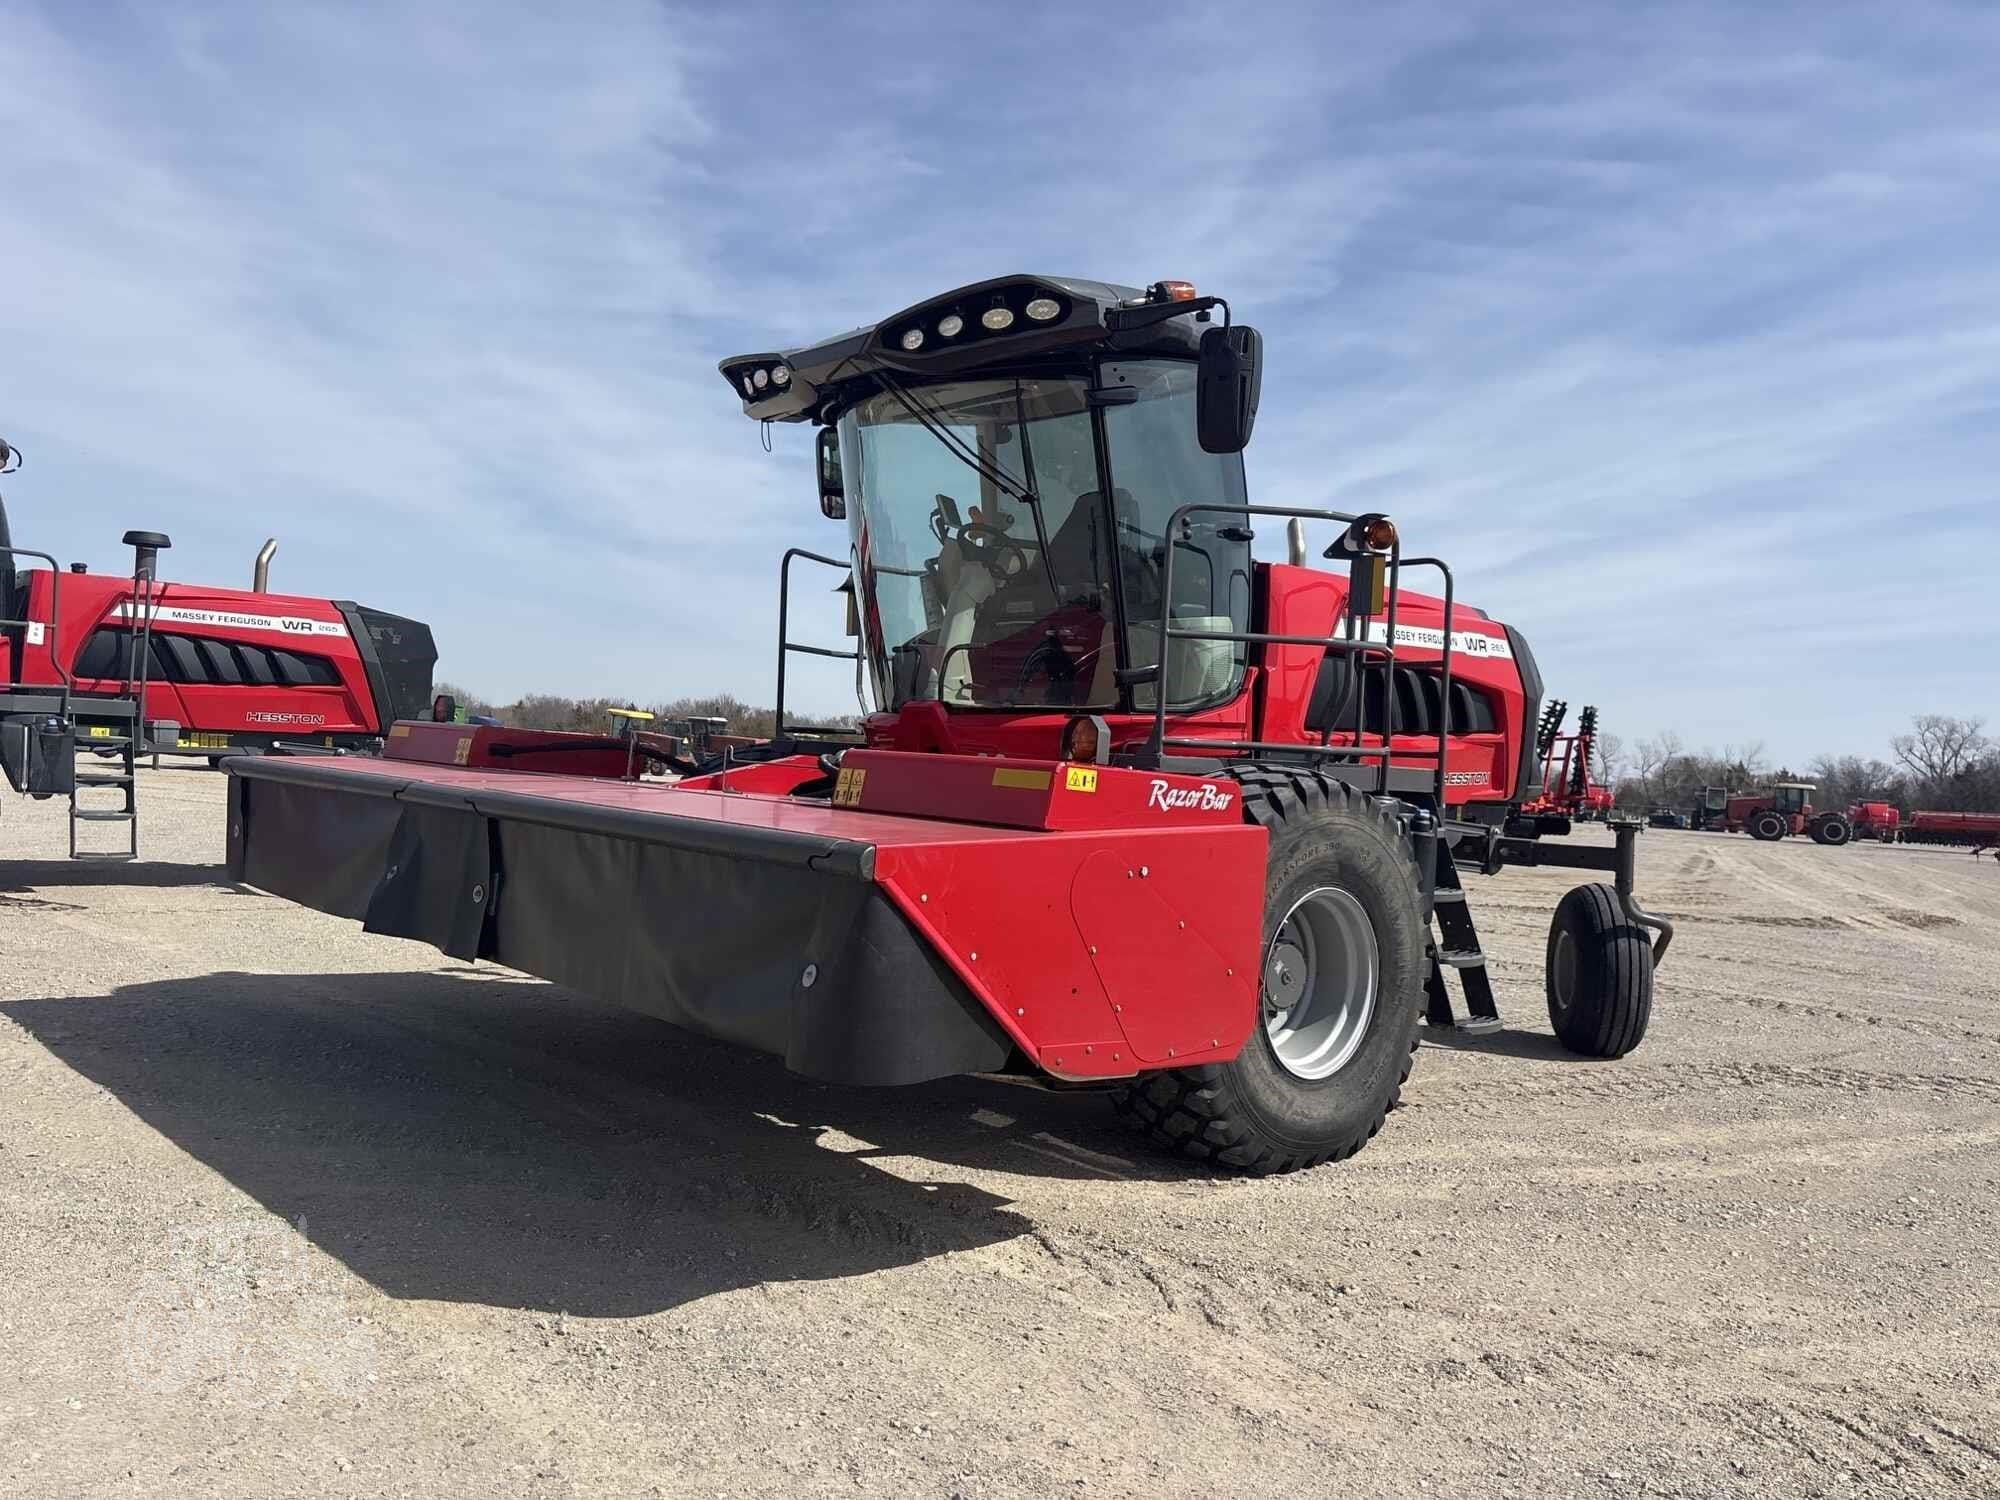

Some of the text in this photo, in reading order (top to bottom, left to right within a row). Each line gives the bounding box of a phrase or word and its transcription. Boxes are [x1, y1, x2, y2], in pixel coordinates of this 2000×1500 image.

[171, 610, 216, 622] MASSEY
[217, 615, 272, 627] FERGUSON
[281, 619, 313, 632] WR
[1382, 628, 1416, 641] MSSEY
[1418, 632, 1458, 647] FERGUN
[1464, 636, 1488, 653] WR
[245, 711, 325, 725] HESSTON
